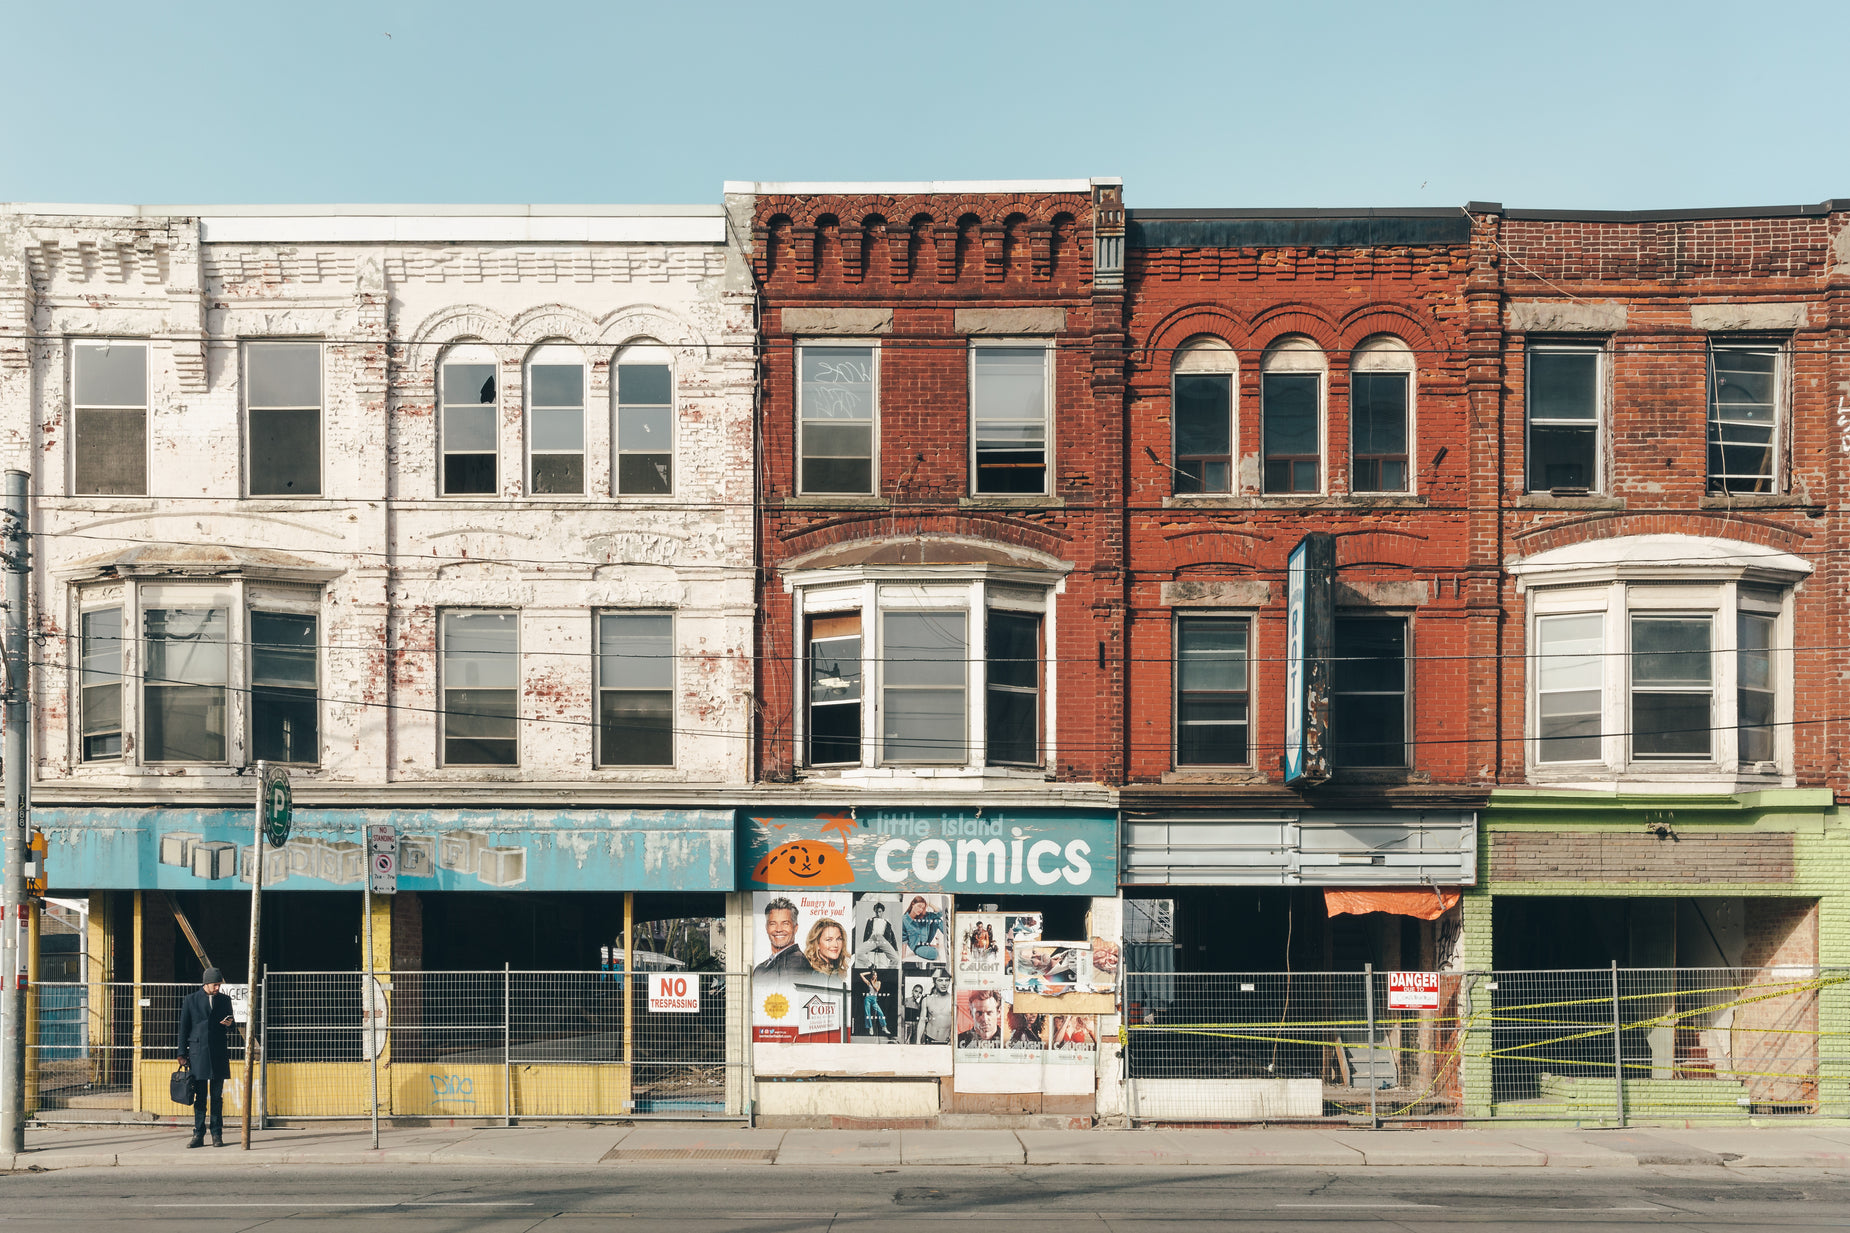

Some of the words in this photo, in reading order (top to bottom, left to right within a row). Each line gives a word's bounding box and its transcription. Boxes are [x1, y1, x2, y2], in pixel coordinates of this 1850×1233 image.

[273, 788, 285, 818] P
[876, 811, 931, 836] little
[941, 812, 1003, 836] island
[874, 827, 1092, 885] comics
[800, 897, 827, 910] Hungry
[828, 898, 836, 907] to
[810, 907, 829, 916] serve
[830, 906, 846, 917] you!
[959, 962, 1000, 972] CAUGHT
[1390, 973, 1438, 987] DANGER
[660, 977, 687, 997] NO
[650, 998, 698, 1009] TRESPASSING
[810, 1005, 836, 1015] COBY
[959, 1040, 1001, 1049] CAUGHT
[1005, 1041, 1047, 1050] CAUGHT
[1053, 1042, 1095, 1051] CAUGHT
[430, 1074, 473, 1095] Dino
